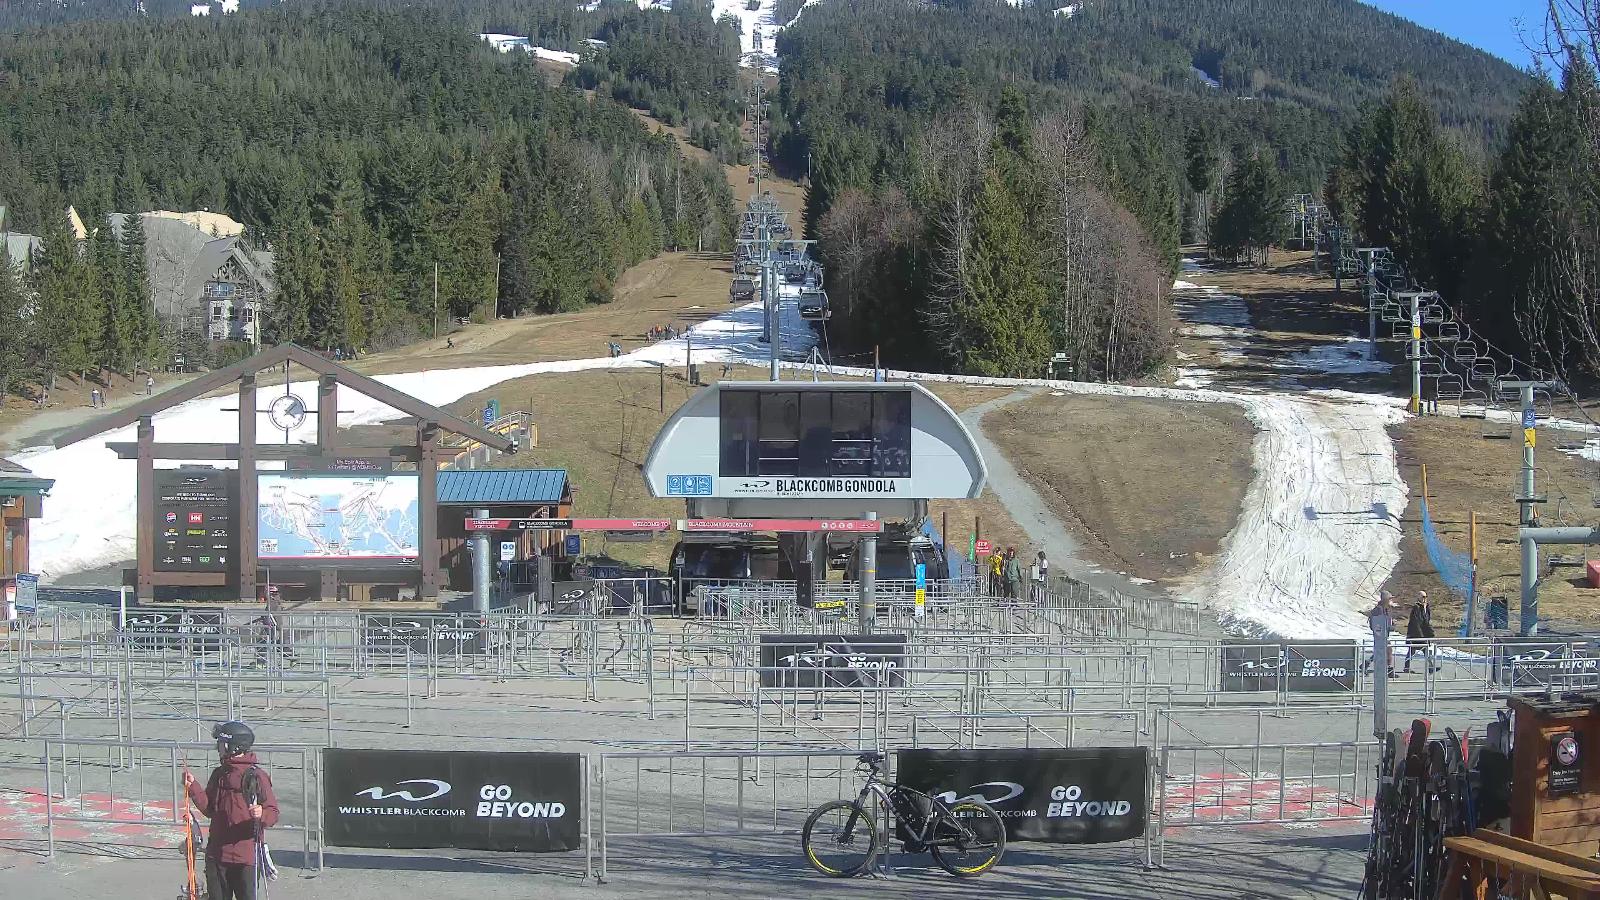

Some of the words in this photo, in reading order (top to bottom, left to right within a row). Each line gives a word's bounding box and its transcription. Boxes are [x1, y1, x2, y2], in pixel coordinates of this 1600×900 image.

[776, 479, 843, 493] BLACKCOMB
[845, 479, 896, 493] GONDOLA
[1303, 659, 1321, 668] GO
[1301, 668, 1347, 677] BEYOND
[479, 784, 512, 801] GO
[1050, 785, 1082, 801] GO
[476, 801, 566, 819] BEYOND
[1046, 800, 1131, 818] BEYOND
